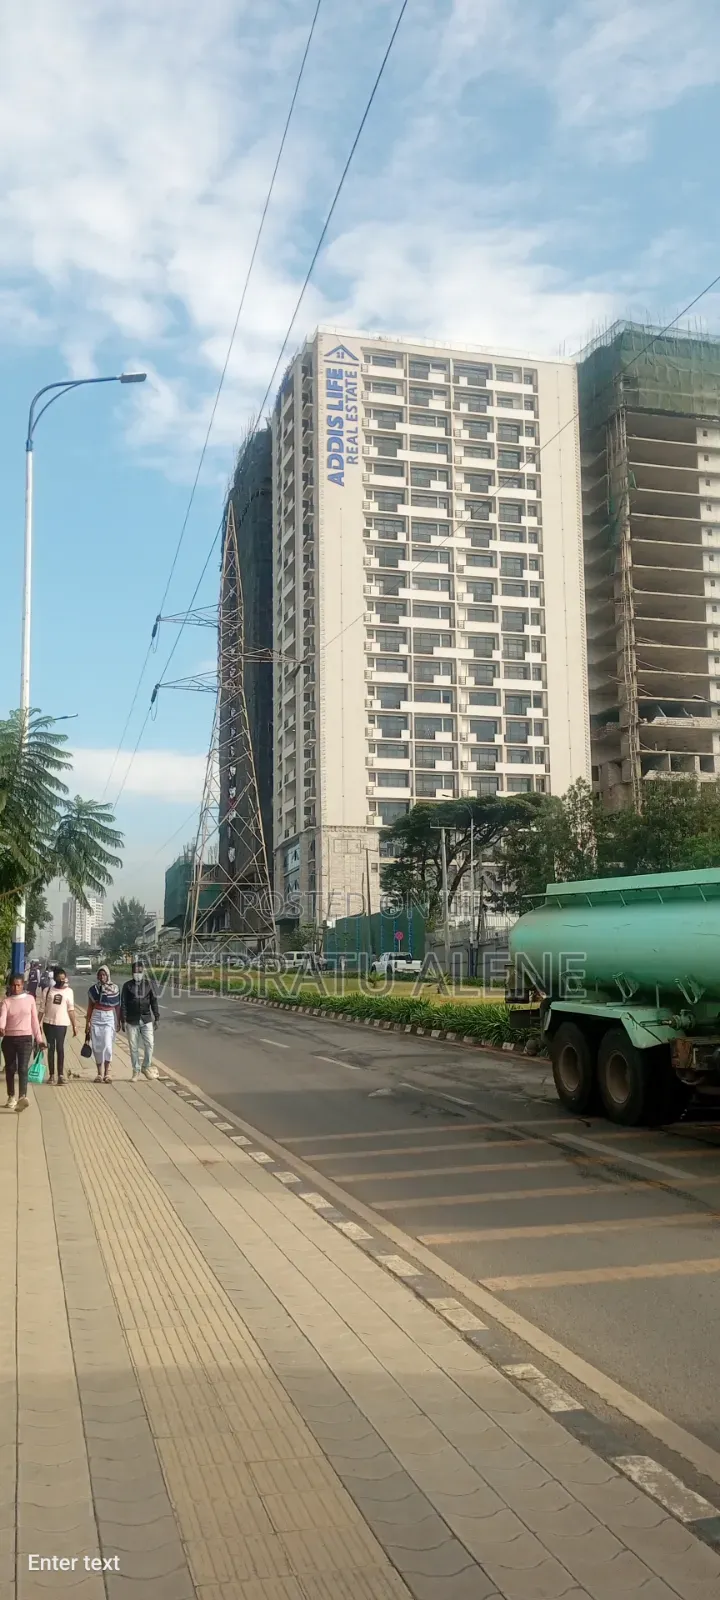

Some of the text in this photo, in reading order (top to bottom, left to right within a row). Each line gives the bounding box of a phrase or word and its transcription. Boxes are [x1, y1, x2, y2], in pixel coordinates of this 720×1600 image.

[326, 368, 345, 487] ADDIS LIFE
[344, 370, 359, 465] REAL ESTATE
